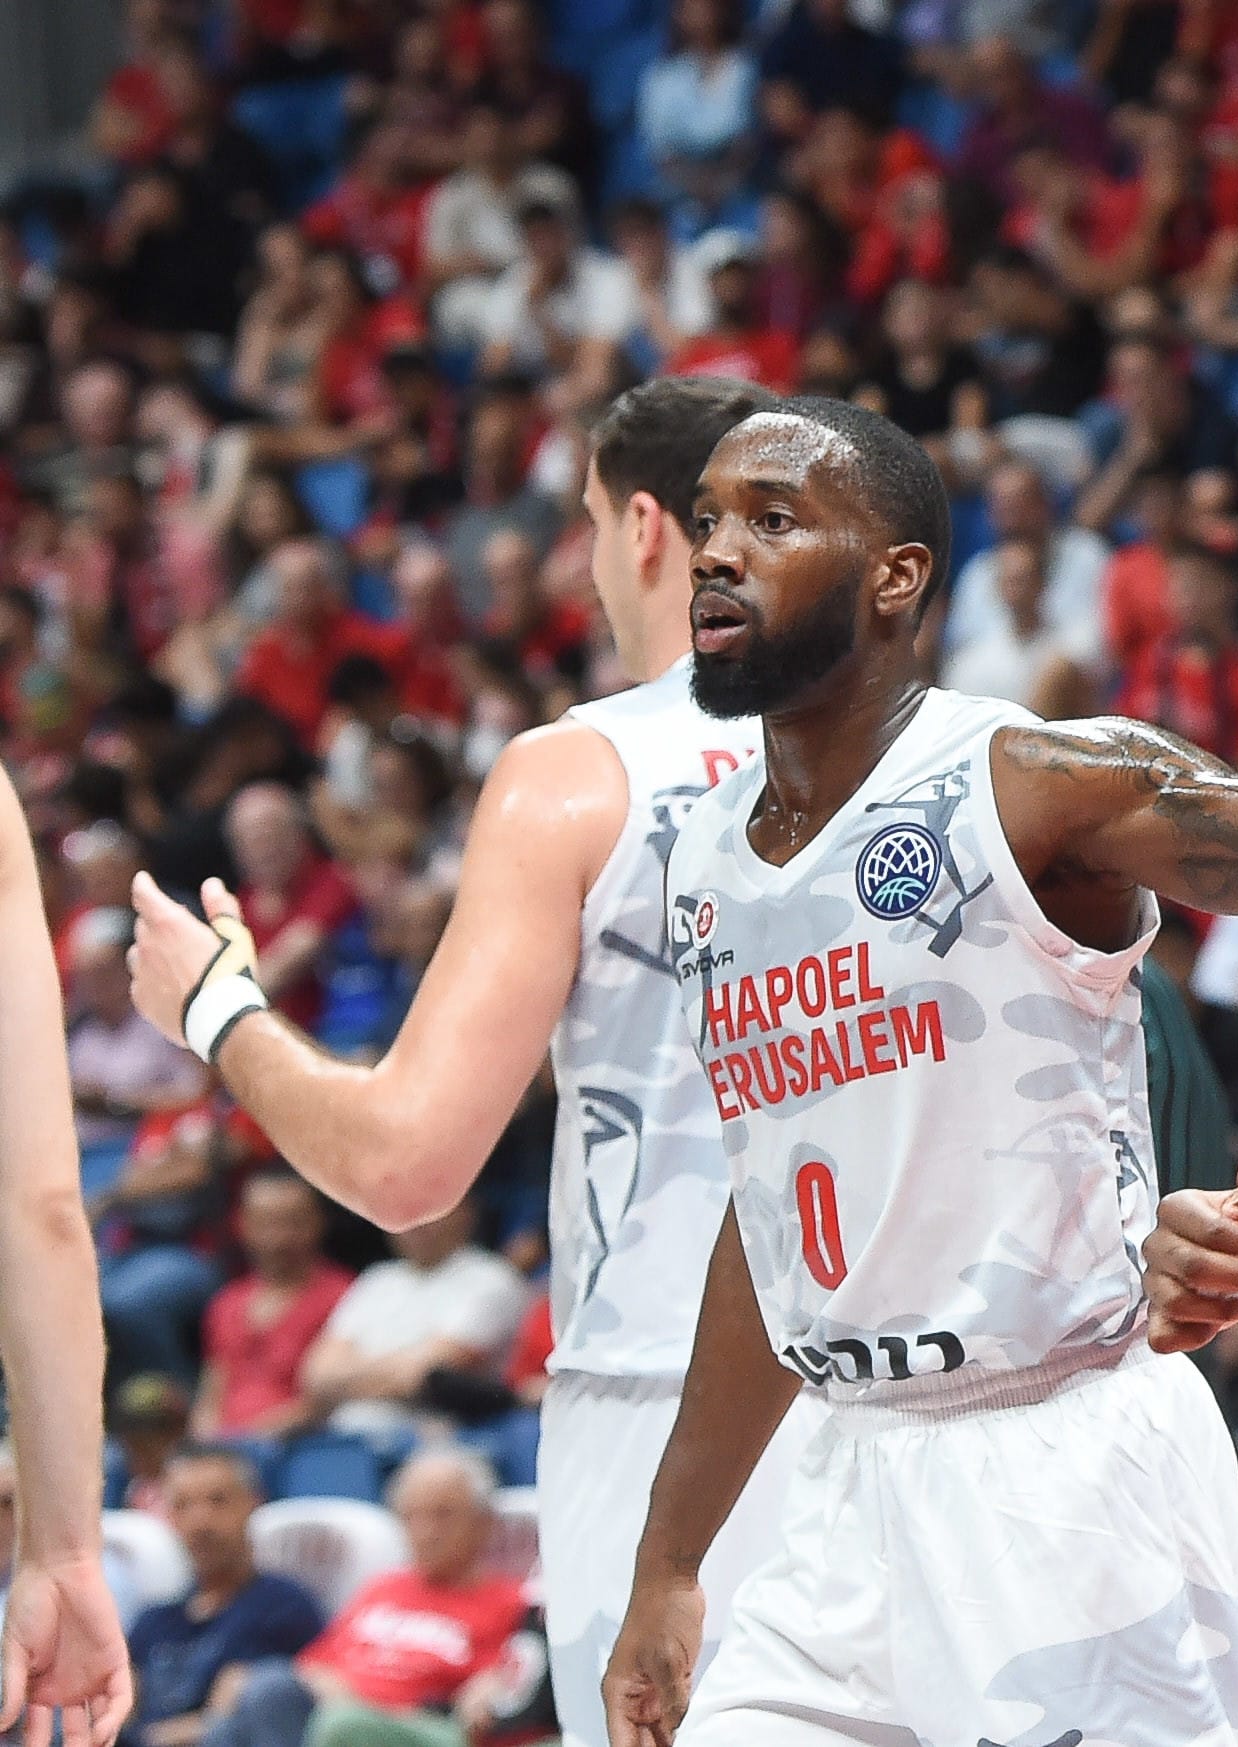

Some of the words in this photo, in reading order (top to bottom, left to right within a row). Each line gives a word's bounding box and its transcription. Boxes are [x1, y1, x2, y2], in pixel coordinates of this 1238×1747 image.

[706, 942, 884, 1047] HAPOEL
[708, 1001, 946, 1122] ERUSALEM
[796, 1161, 848, 1291] 0
